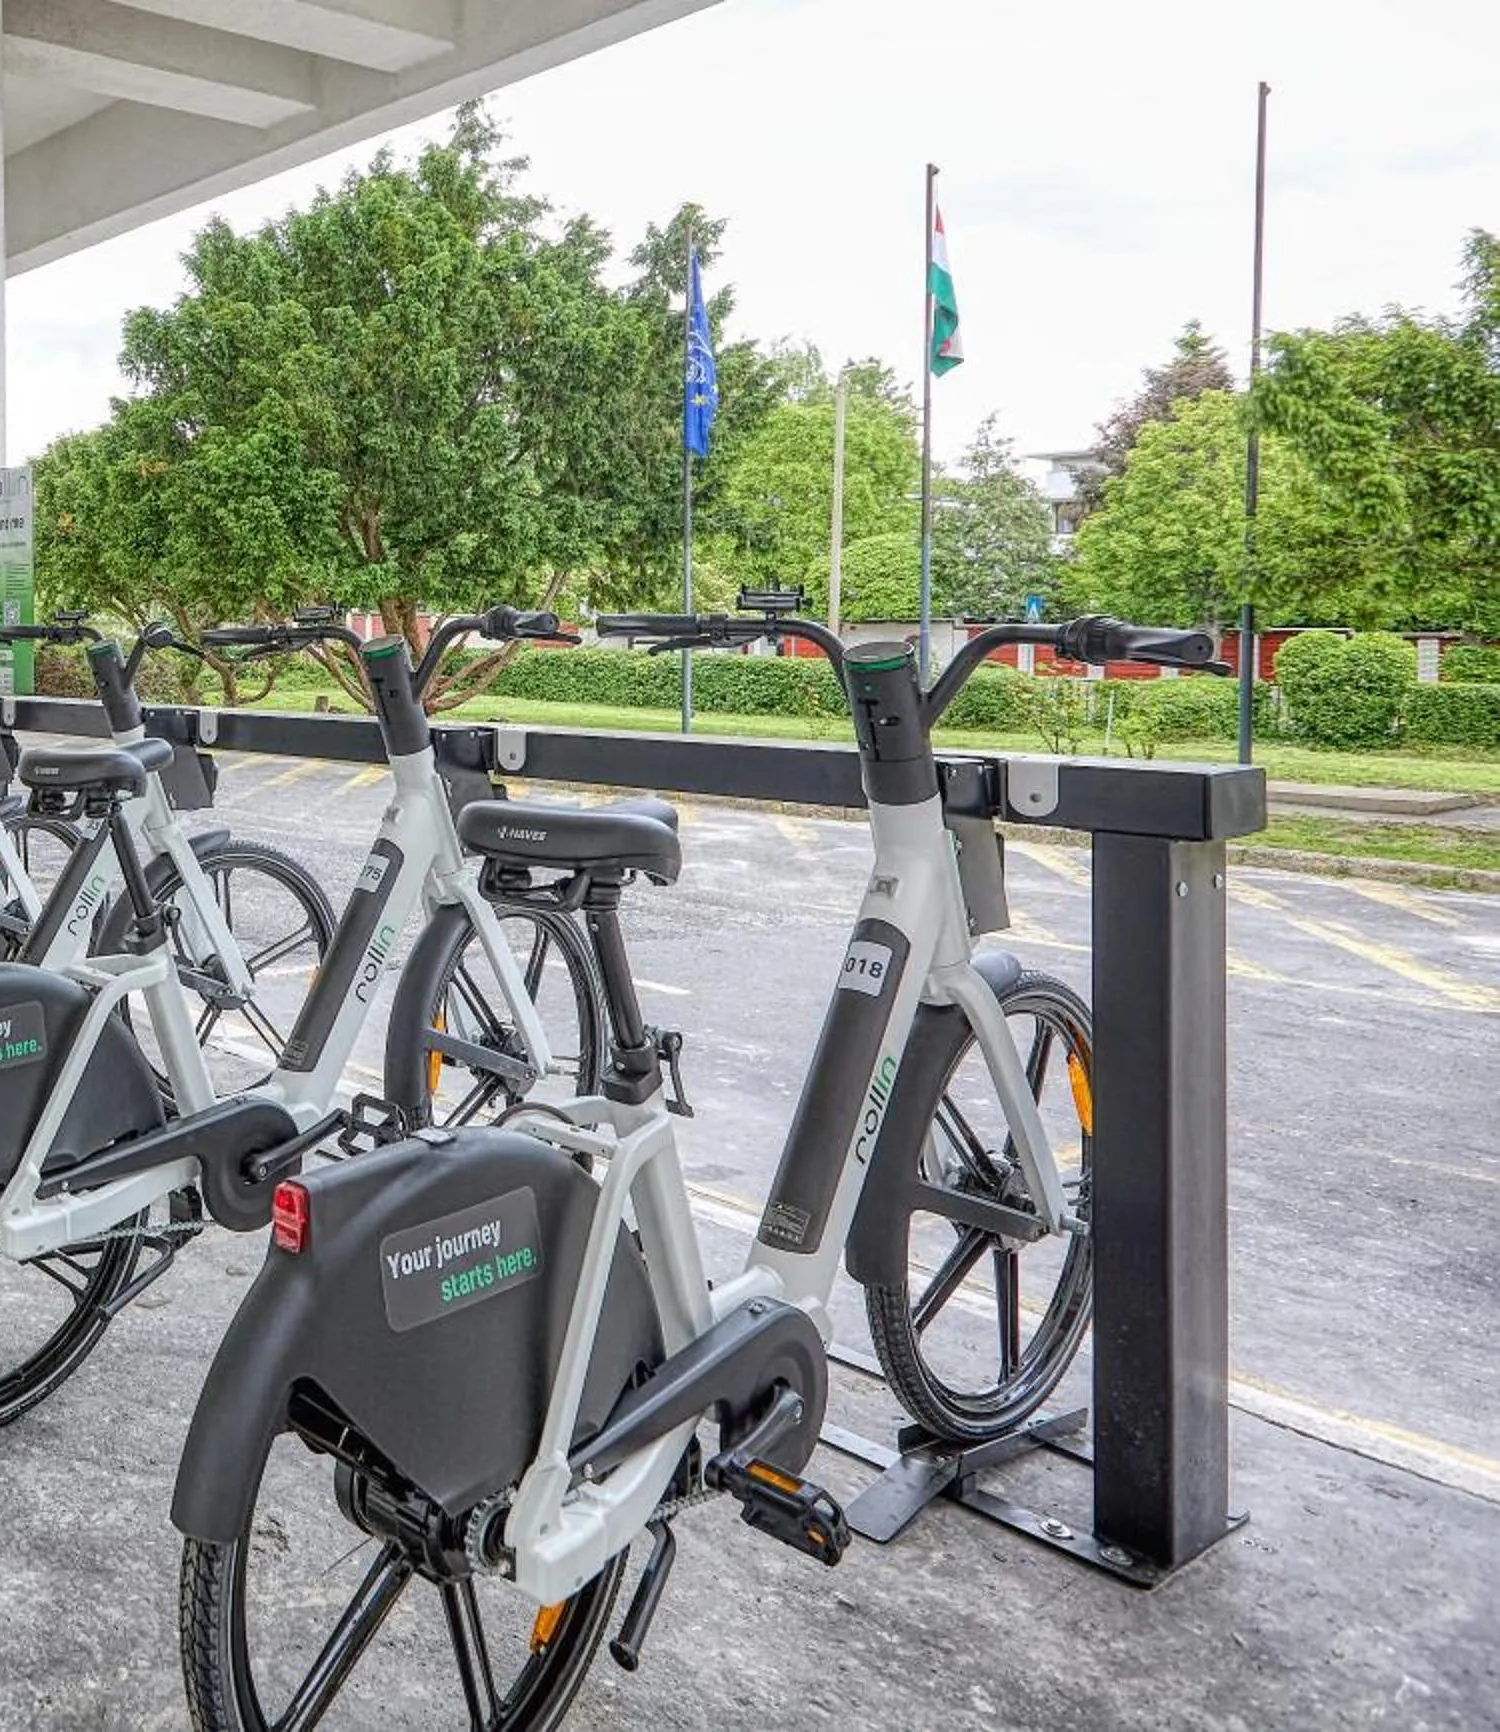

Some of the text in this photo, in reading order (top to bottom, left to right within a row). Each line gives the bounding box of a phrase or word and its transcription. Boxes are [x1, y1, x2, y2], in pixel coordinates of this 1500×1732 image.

[67, 875, 104, 936] rollin
[355, 925, 396, 1004] rollin
[845, 957, 883, 979] 018
[5, 1039, 43, 1059] here.
[855, 1056, 897, 1165] rollin
[387, 1219, 501, 1279] Your journey
[441, 1247, 538, 1302] starts here.
